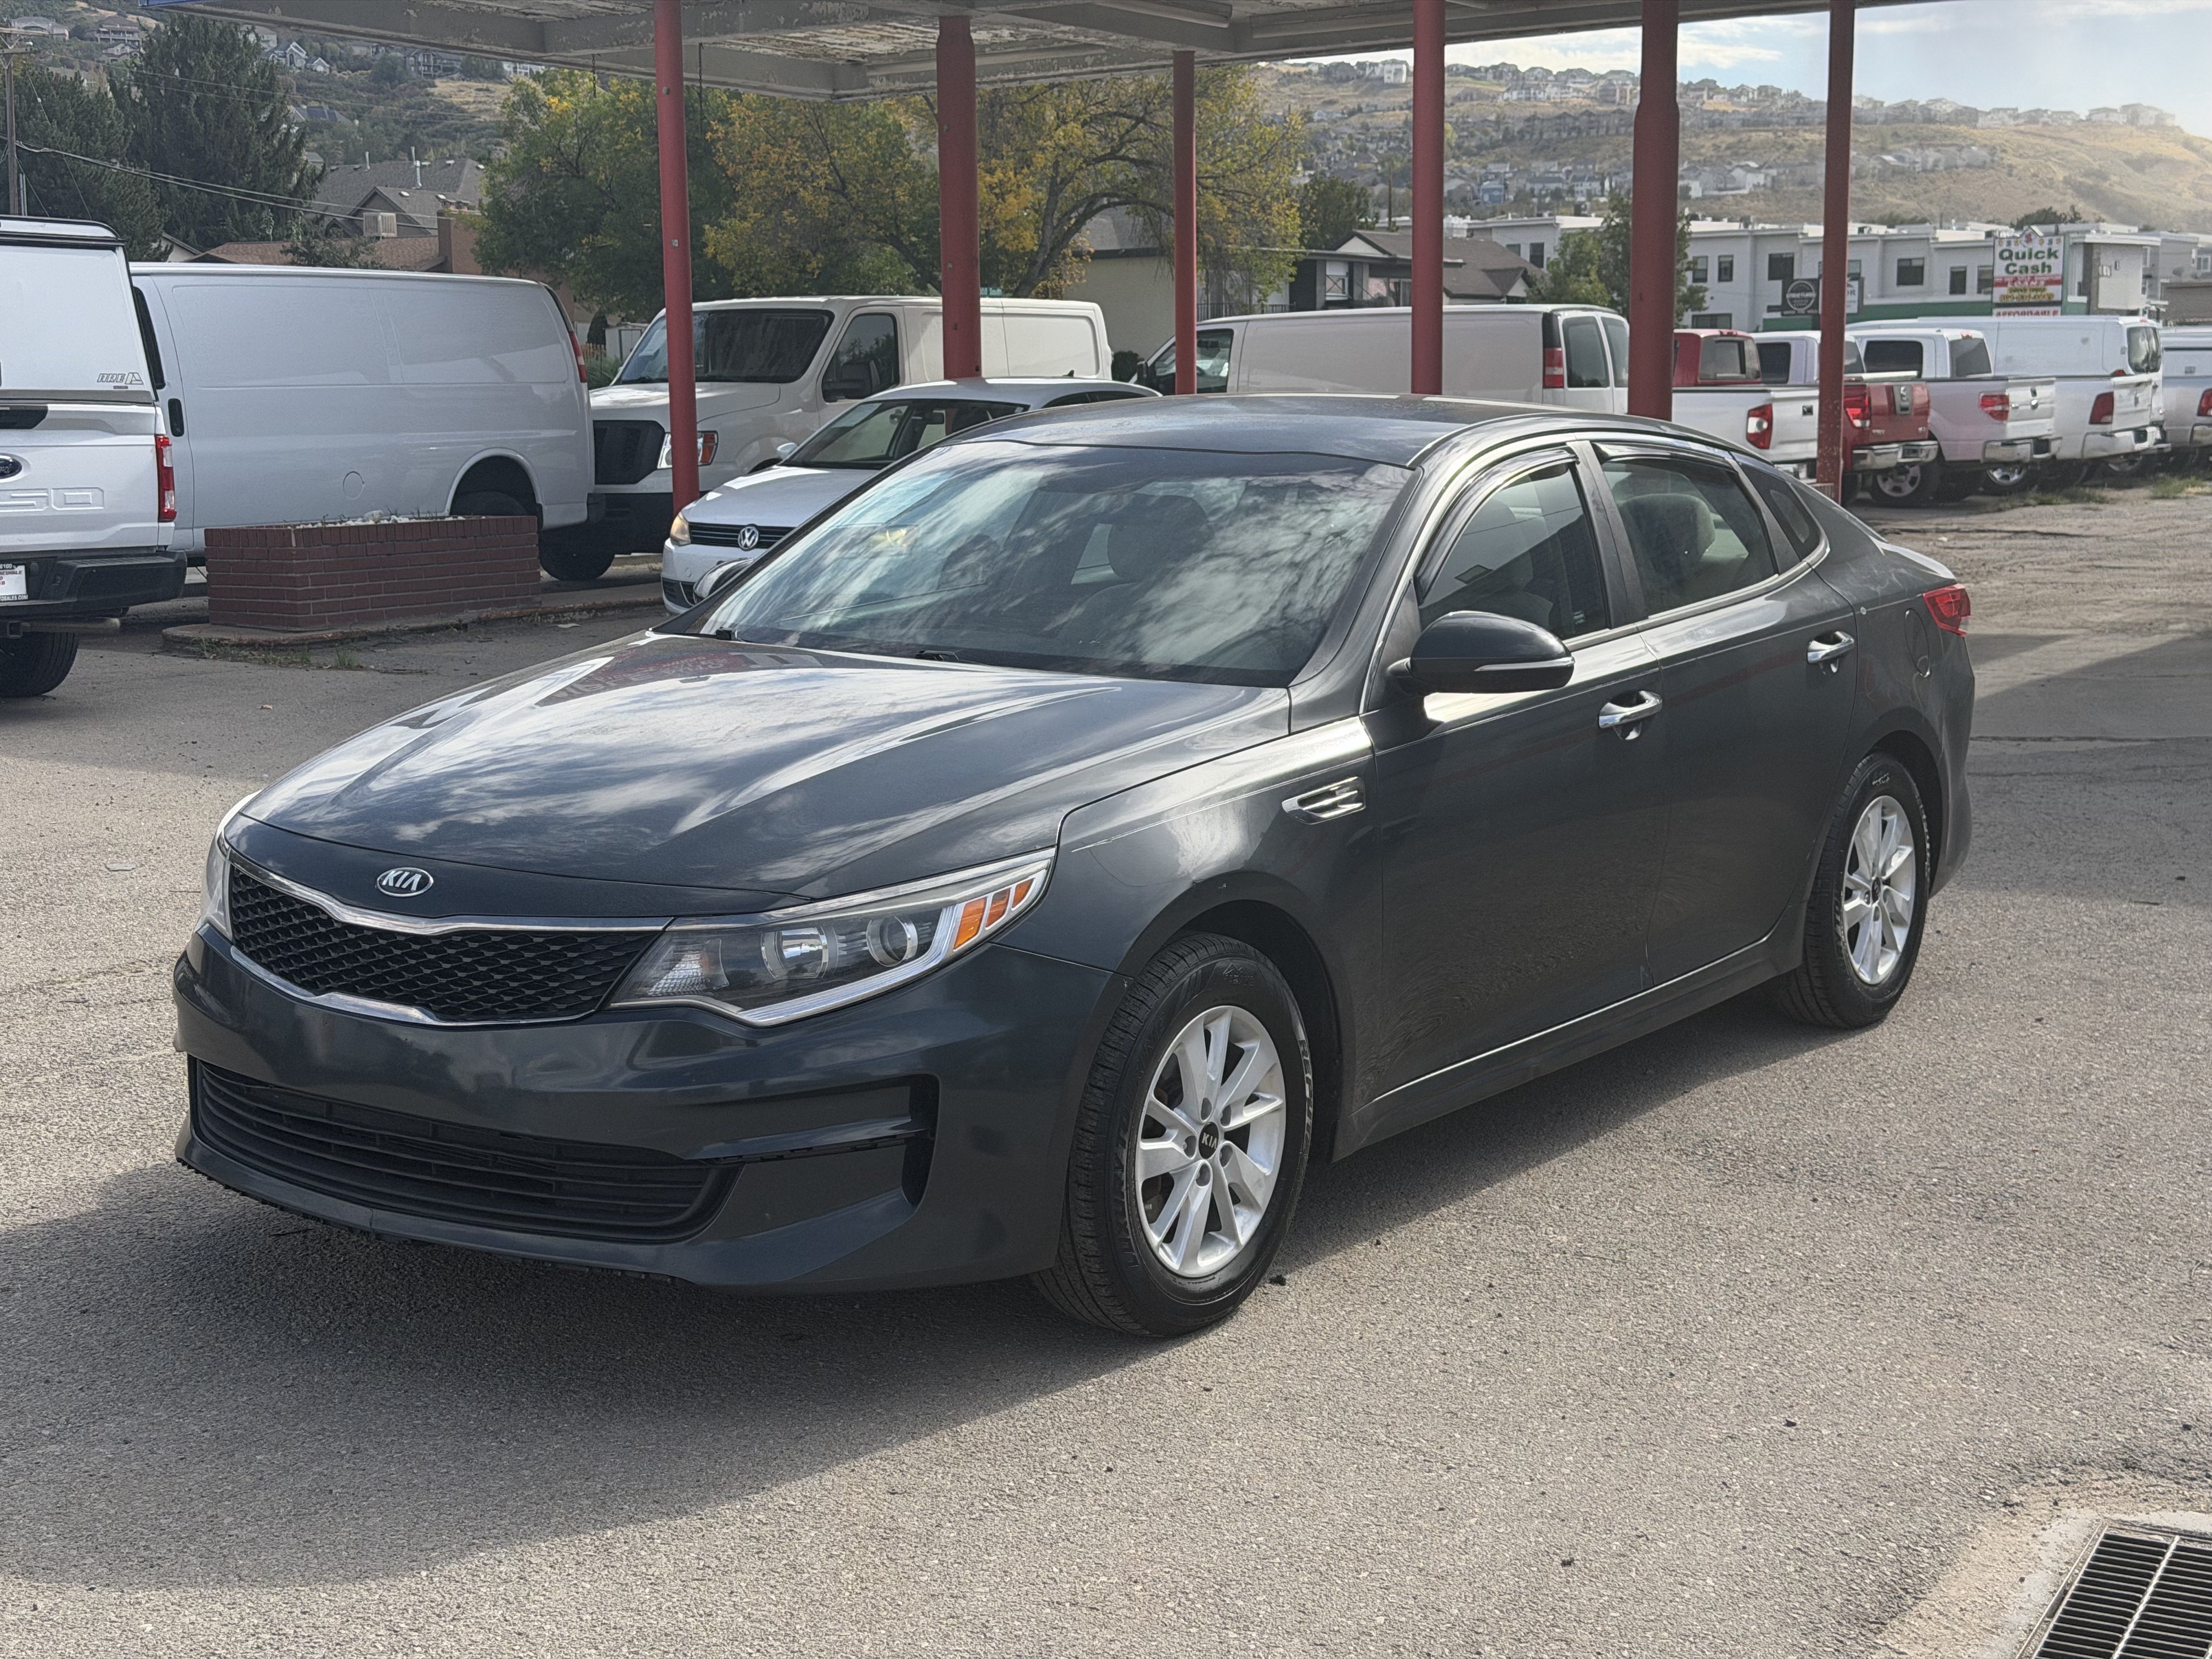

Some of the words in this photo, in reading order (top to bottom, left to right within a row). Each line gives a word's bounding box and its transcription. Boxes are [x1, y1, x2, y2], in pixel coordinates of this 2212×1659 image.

[1999, 247, 2059, 261] Quick
[2005, 262, 2052, 274] Cash
[382, 870, 422, 891] KIA
[1201, 1132, 1217, 1149] KIA
